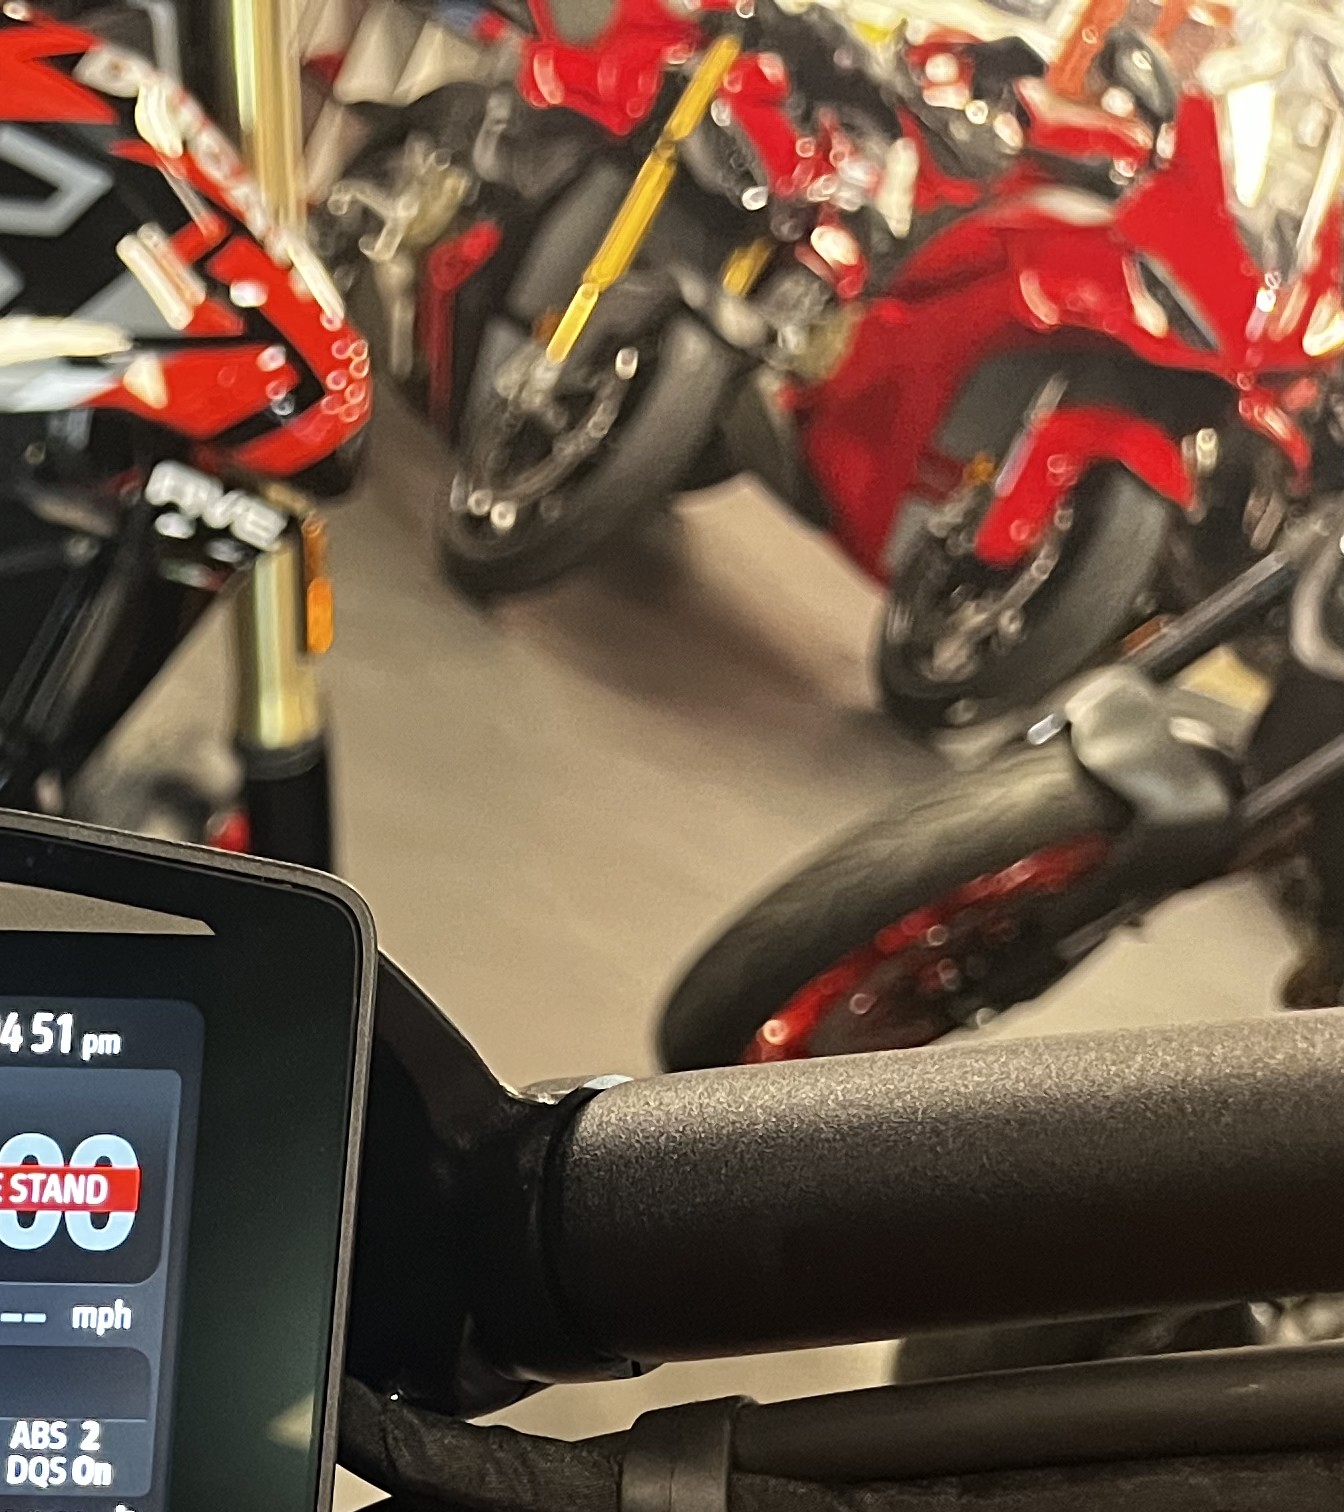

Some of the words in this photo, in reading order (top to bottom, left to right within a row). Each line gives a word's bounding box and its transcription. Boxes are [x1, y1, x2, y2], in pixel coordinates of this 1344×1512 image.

[80, 1033, 122, 1062] pm
[9, 1172, 109, 1205] STAND
[71, 1298, 132, 1337] mph
[8, 1420, 68, 1450] ABS
[79, 1419, 101, 1452] 2
[6, 1454, 68, 1489] DQS
[71, 1454, 112, 1486] On
